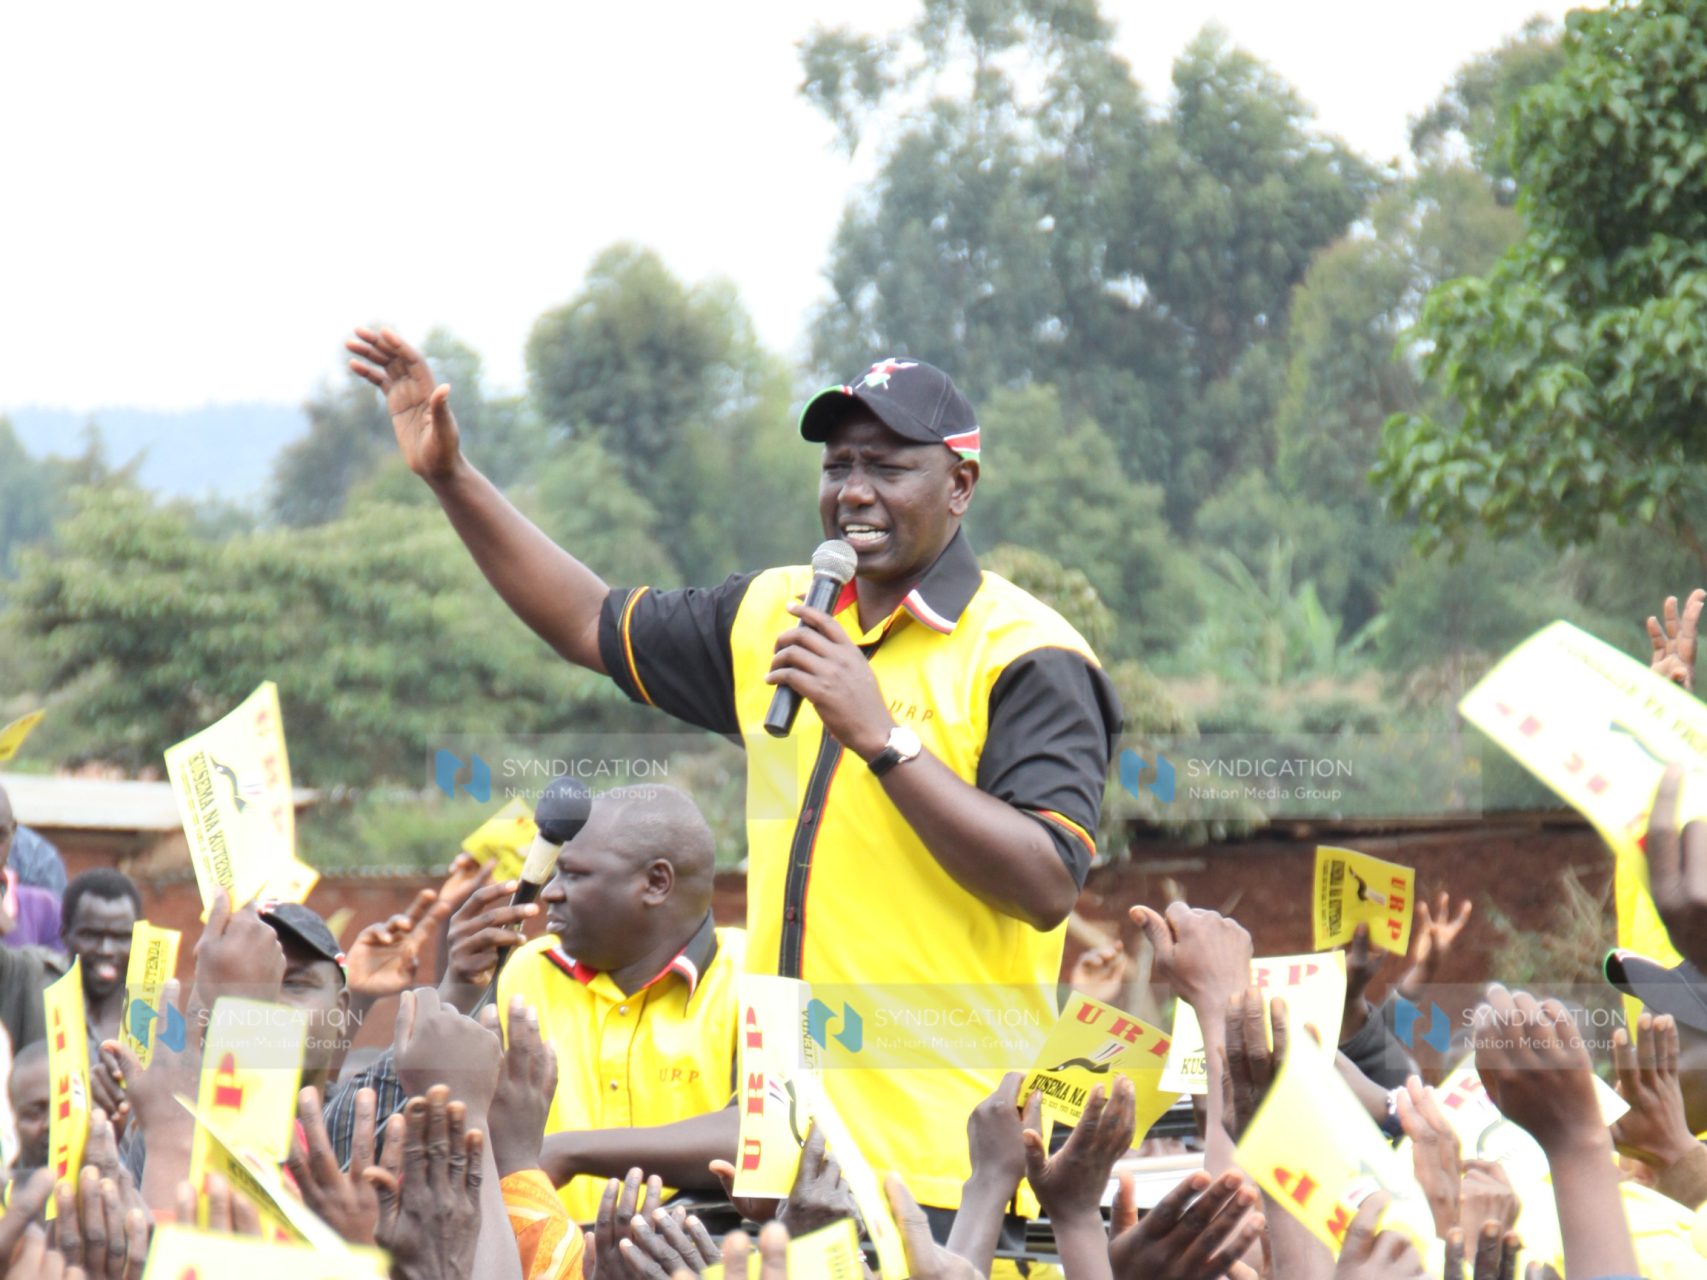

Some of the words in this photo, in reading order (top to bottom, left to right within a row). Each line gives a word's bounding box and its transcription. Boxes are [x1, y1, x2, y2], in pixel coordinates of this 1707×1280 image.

[889, 699, 934, 722] URP
[203, 809, 220, 832] NA
[1387, 876, 1406, 941] URP
[659, 1067, 699, 1084] URP
[740, 1005, 766, 1172] URP
[1028, 1073, 1070, 1101] KUSEMA
[1067, 1085, 1088, 1107] NA
